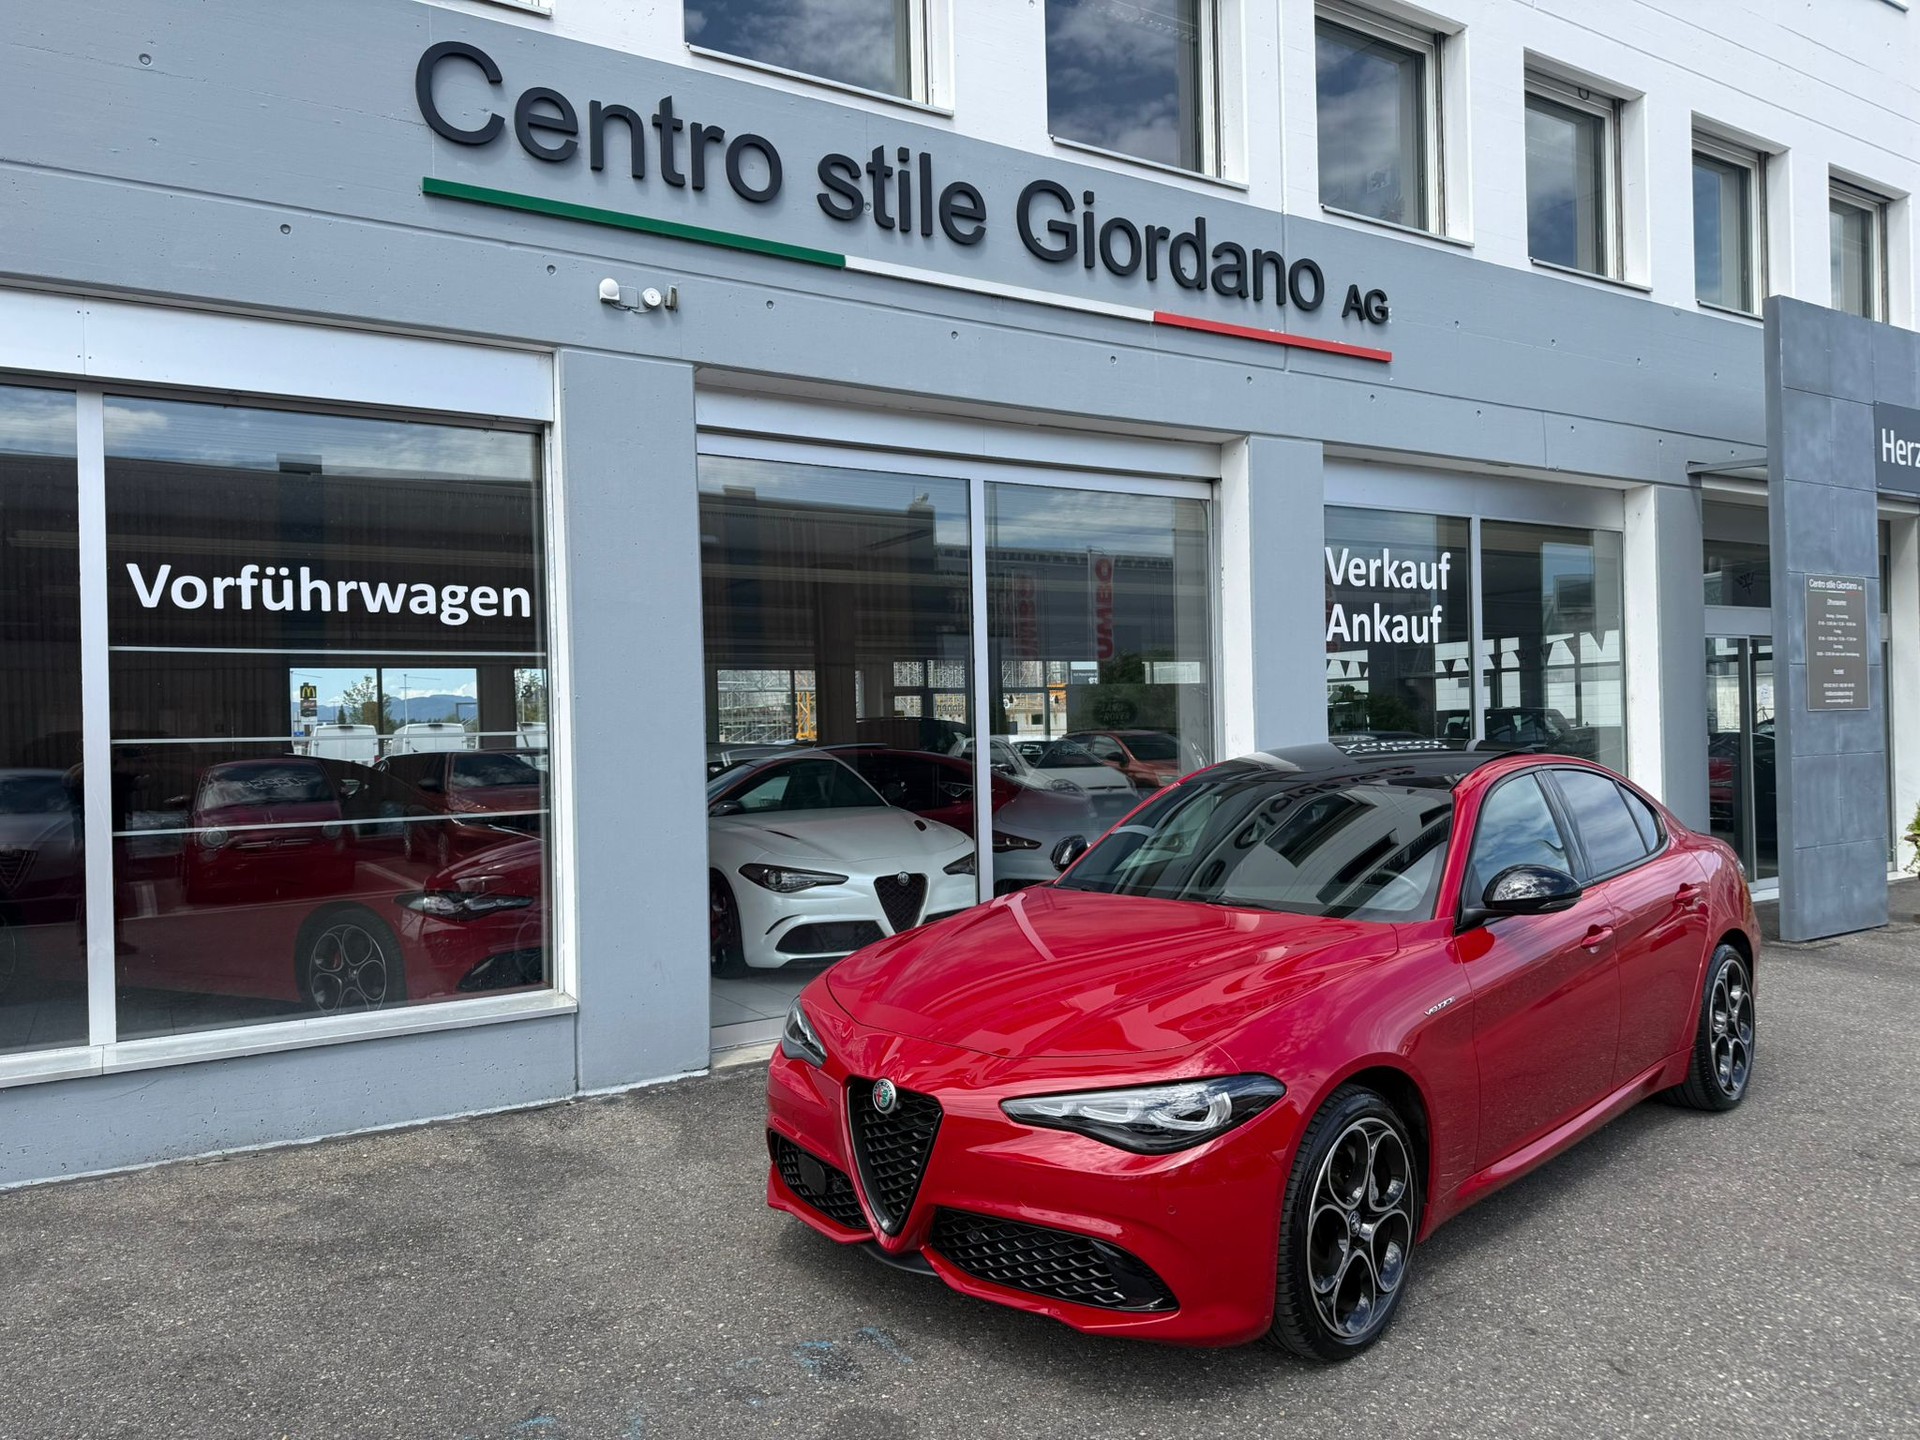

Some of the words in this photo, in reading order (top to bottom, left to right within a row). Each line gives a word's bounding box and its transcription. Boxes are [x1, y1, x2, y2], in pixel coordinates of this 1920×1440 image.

[415, 40, 783, 206] Centro
[816, 145, 988, 249] stile
[1016, 178, 1325, 313] Giordano
[1341, 284, 1390, 326] AG
[1881, 427, 1920, 468] Herz
[1324, 546, 1451, 591] Verkauf
[126, 563, 531, 627] Vorführwagen
[1325, 602, 1443, 644] Ankauf
